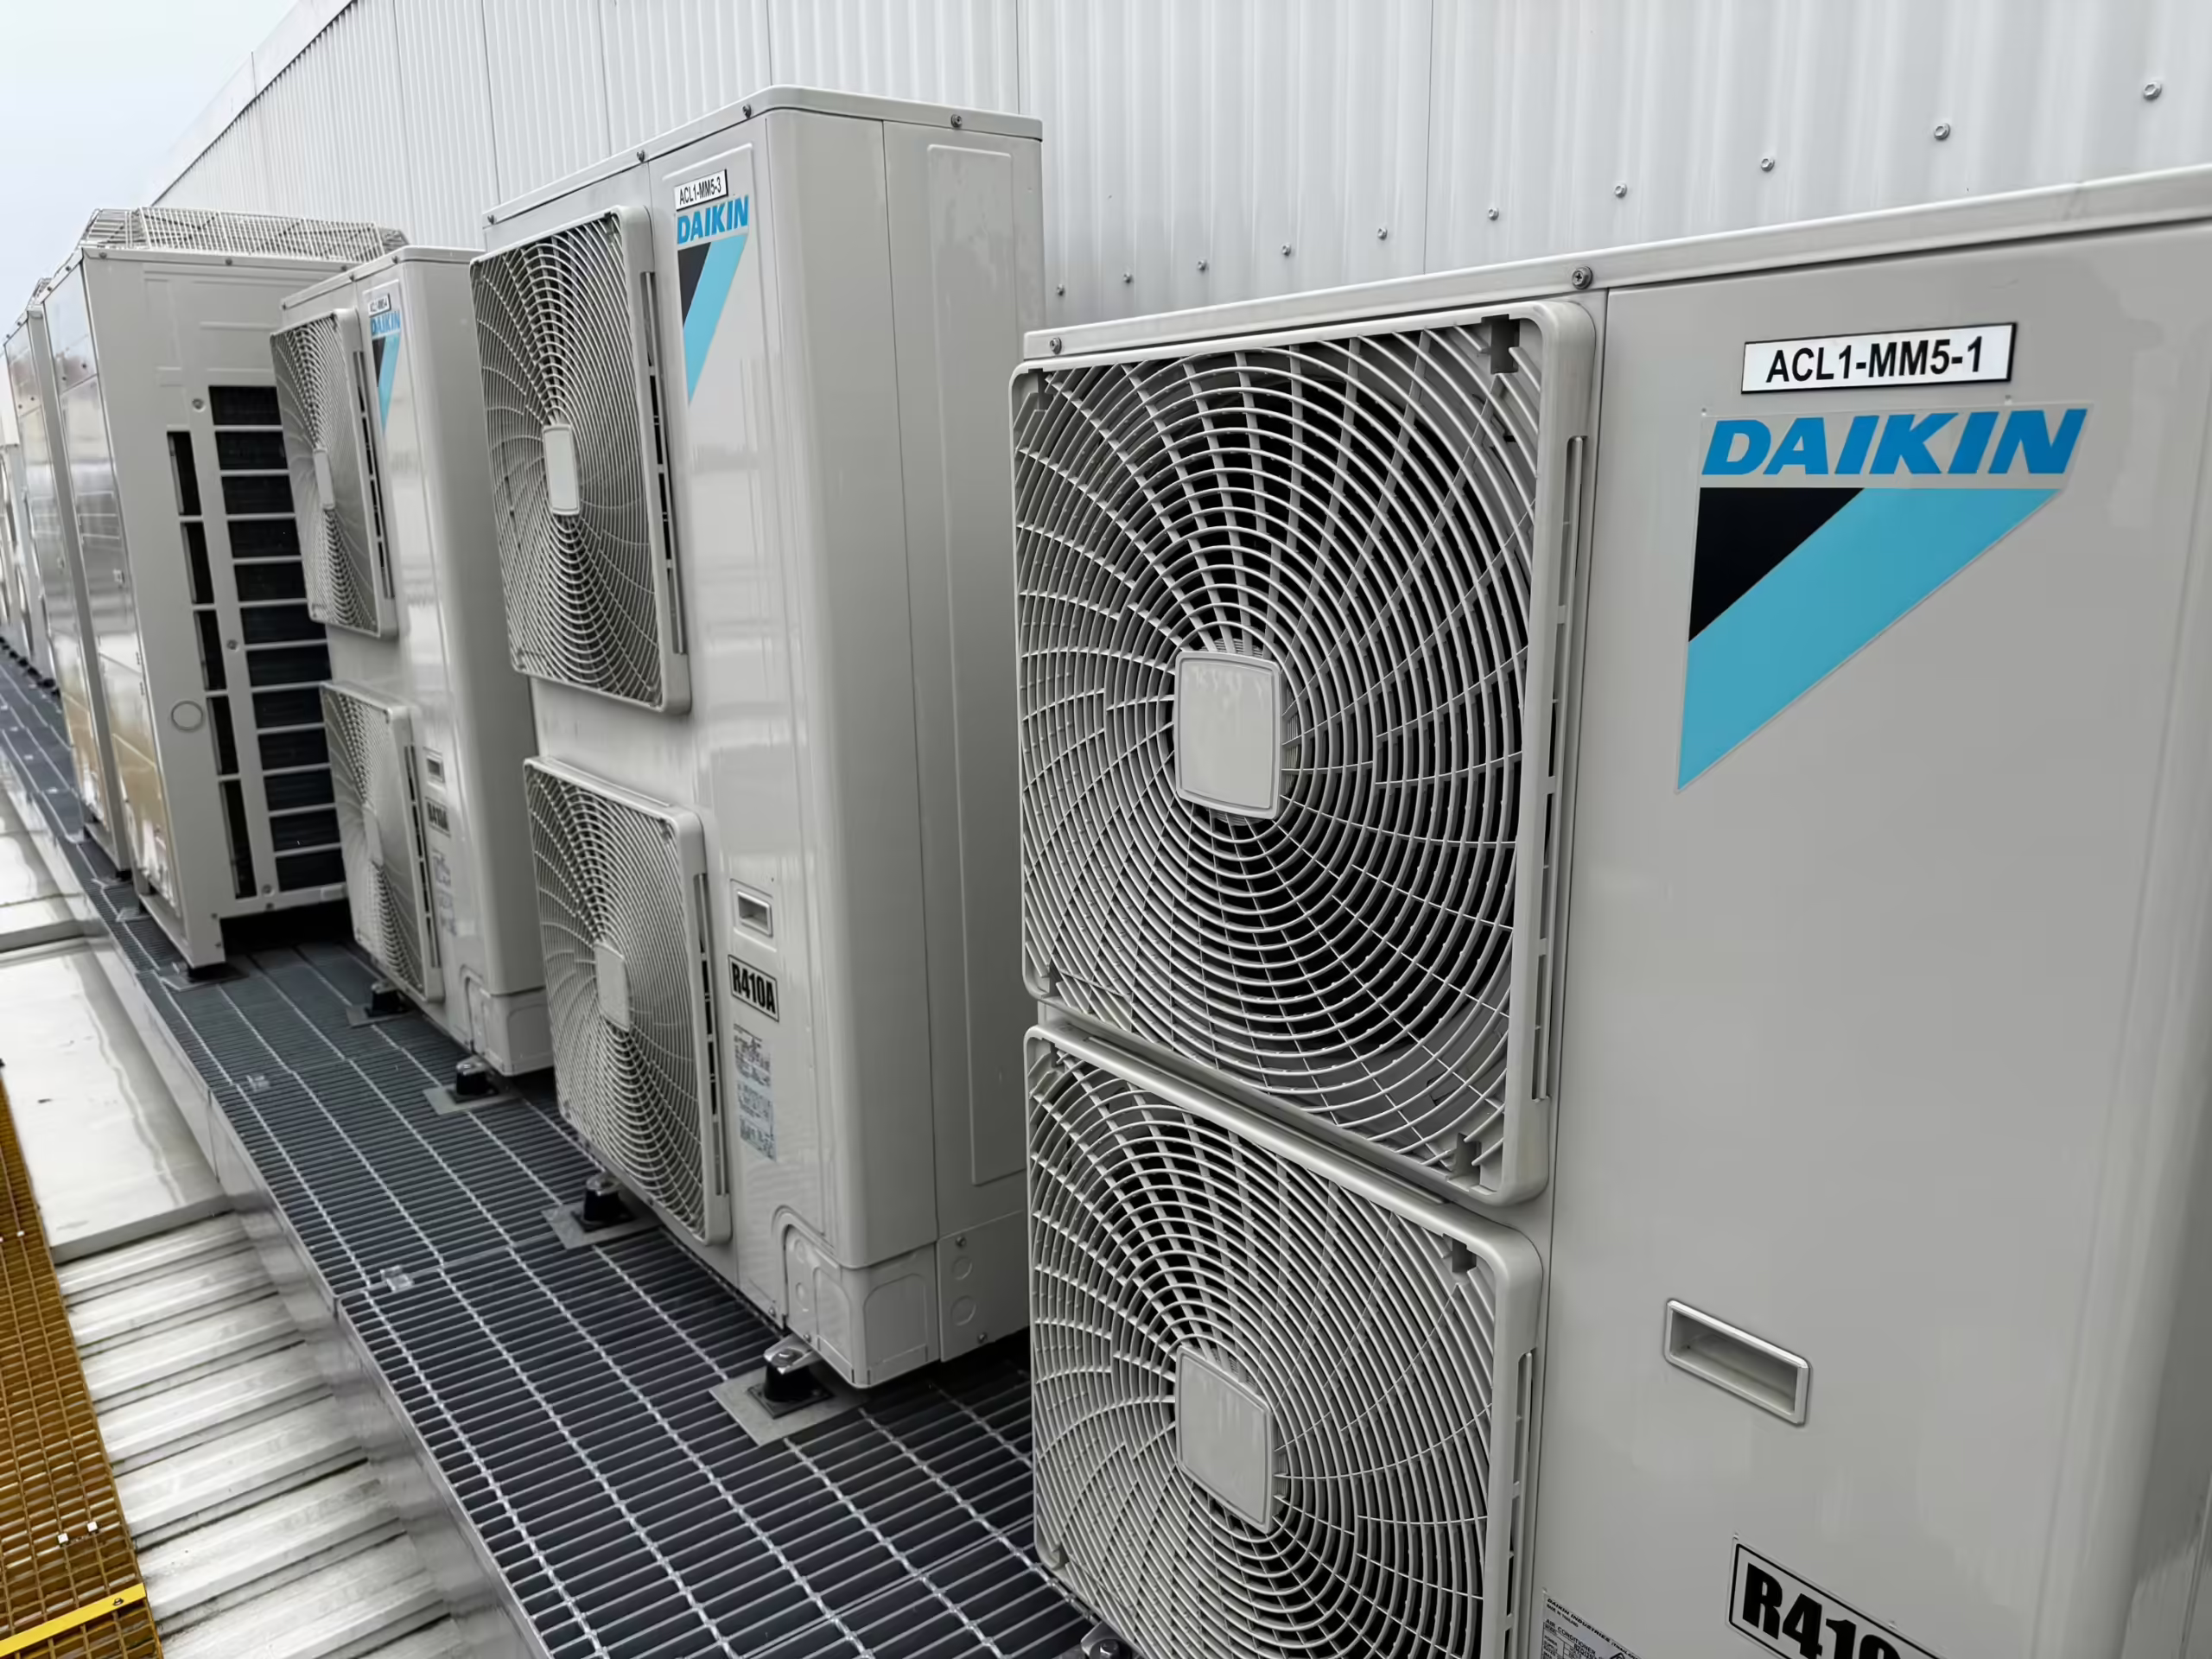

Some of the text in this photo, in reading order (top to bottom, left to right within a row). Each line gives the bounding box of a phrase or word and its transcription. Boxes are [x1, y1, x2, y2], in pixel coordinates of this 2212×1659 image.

[679, 176, 721, 206] ACL1-MM5-3
[677, 194, 749, 245] DAIKIN
[370, 309, 400, 336] DAIKIN
[1765, 335, 1983, 383] ACL1-MM5-1
[1701, 409, 2088, 475] DAIKIN
[732, 962, 776, 1014] R410A
[1546, 1618, 1555, 1628] AIR
[1557, 1626, 1596, 1656] CONDITIONER
[1547, 1598, 1570, 1615] DAIKIN
[1570, 1613, 1611, 1643] INDUSTRIES
